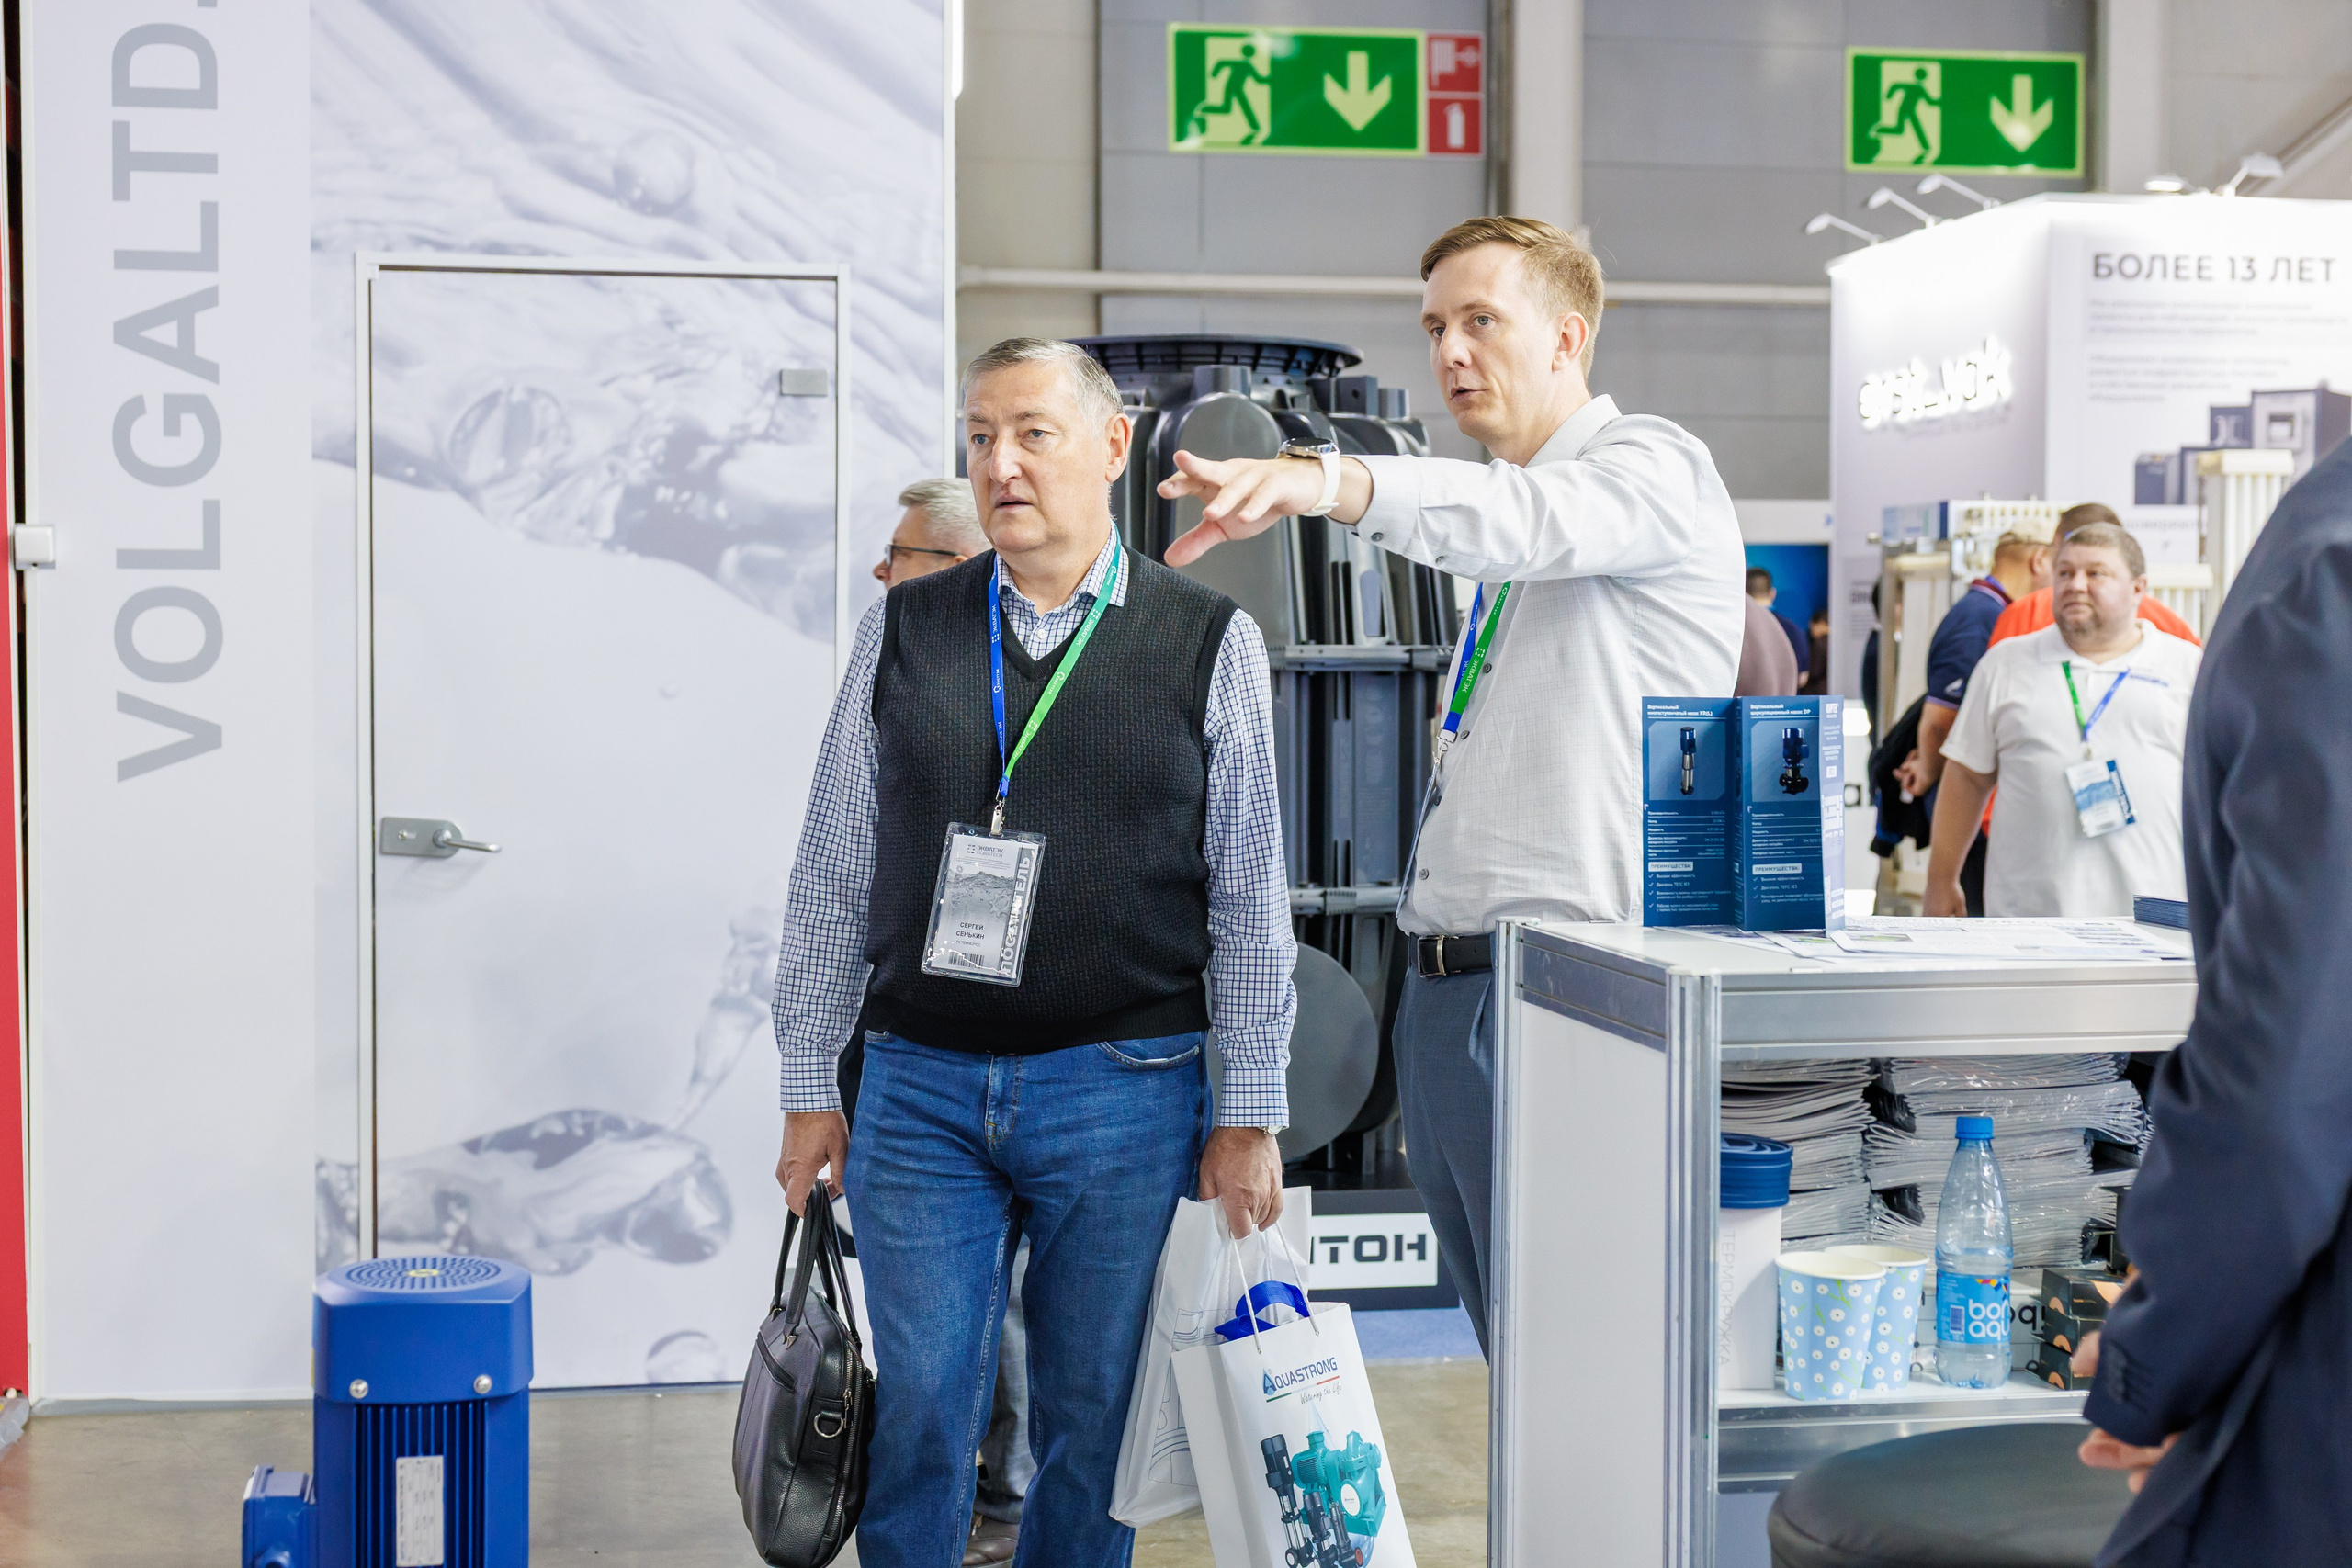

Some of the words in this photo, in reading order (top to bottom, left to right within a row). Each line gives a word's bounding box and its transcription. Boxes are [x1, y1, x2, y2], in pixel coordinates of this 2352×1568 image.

[2092, 253, 2213, 280] БОЛЕЕ
[2227, 256, 2257, 282] 13
[2269, 257, 2336, 282] ЛЕТ
[1077, 617, 1094, 647] ЭКВАТЭК
[1462, 658, 1480, 693] ЭКВАТЭК
[978, 845, 1004, 853] ЭКВАТЭК
[959, 921, 984, 931] СЕРГЕЙ
[1001, 857, 1031, 976] ПОСЕТТЕЛЬ
[956, 931, 985, 940] СЕНЬКИН
[1310, 1233, 1427, 1265] ТОН
[1719, 1230, 1736, 1366] ТЕРМОКРУЖКА
[1968, 1298, 2010, 1321] bon
[1262, 1357, 1338, 1395] AQUASTRONG
[1299, 1390, 1323, 1404] Watering
[1323, 1388, 1331, 1396] the
